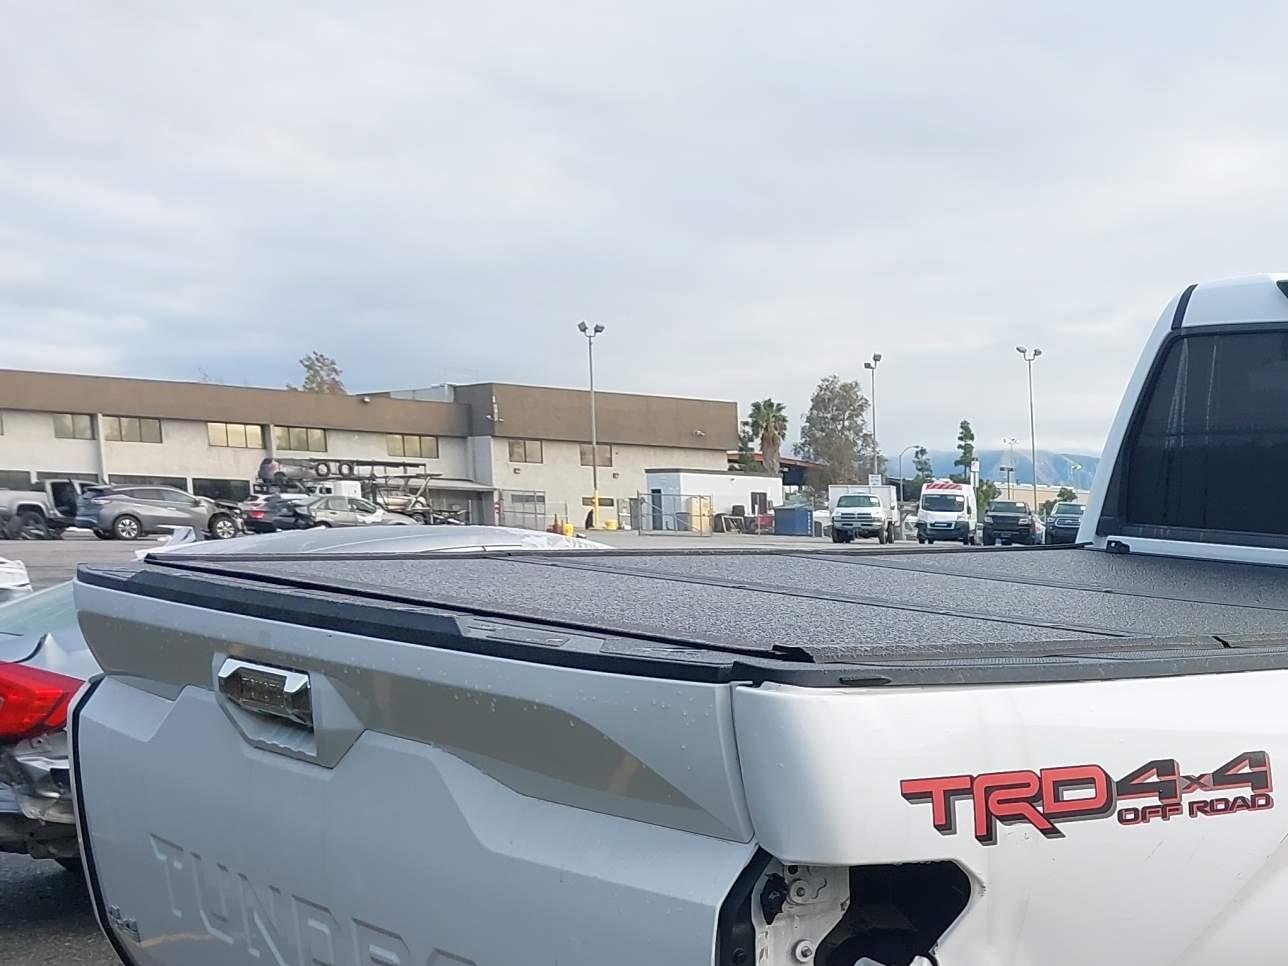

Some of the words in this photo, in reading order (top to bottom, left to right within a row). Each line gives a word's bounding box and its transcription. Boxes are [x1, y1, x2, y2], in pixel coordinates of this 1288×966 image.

[899, 764, 1117, 846] TRD
[1117, 802, 1183, 826] OFF
[1188, 793, 1275, 819] ROAD
